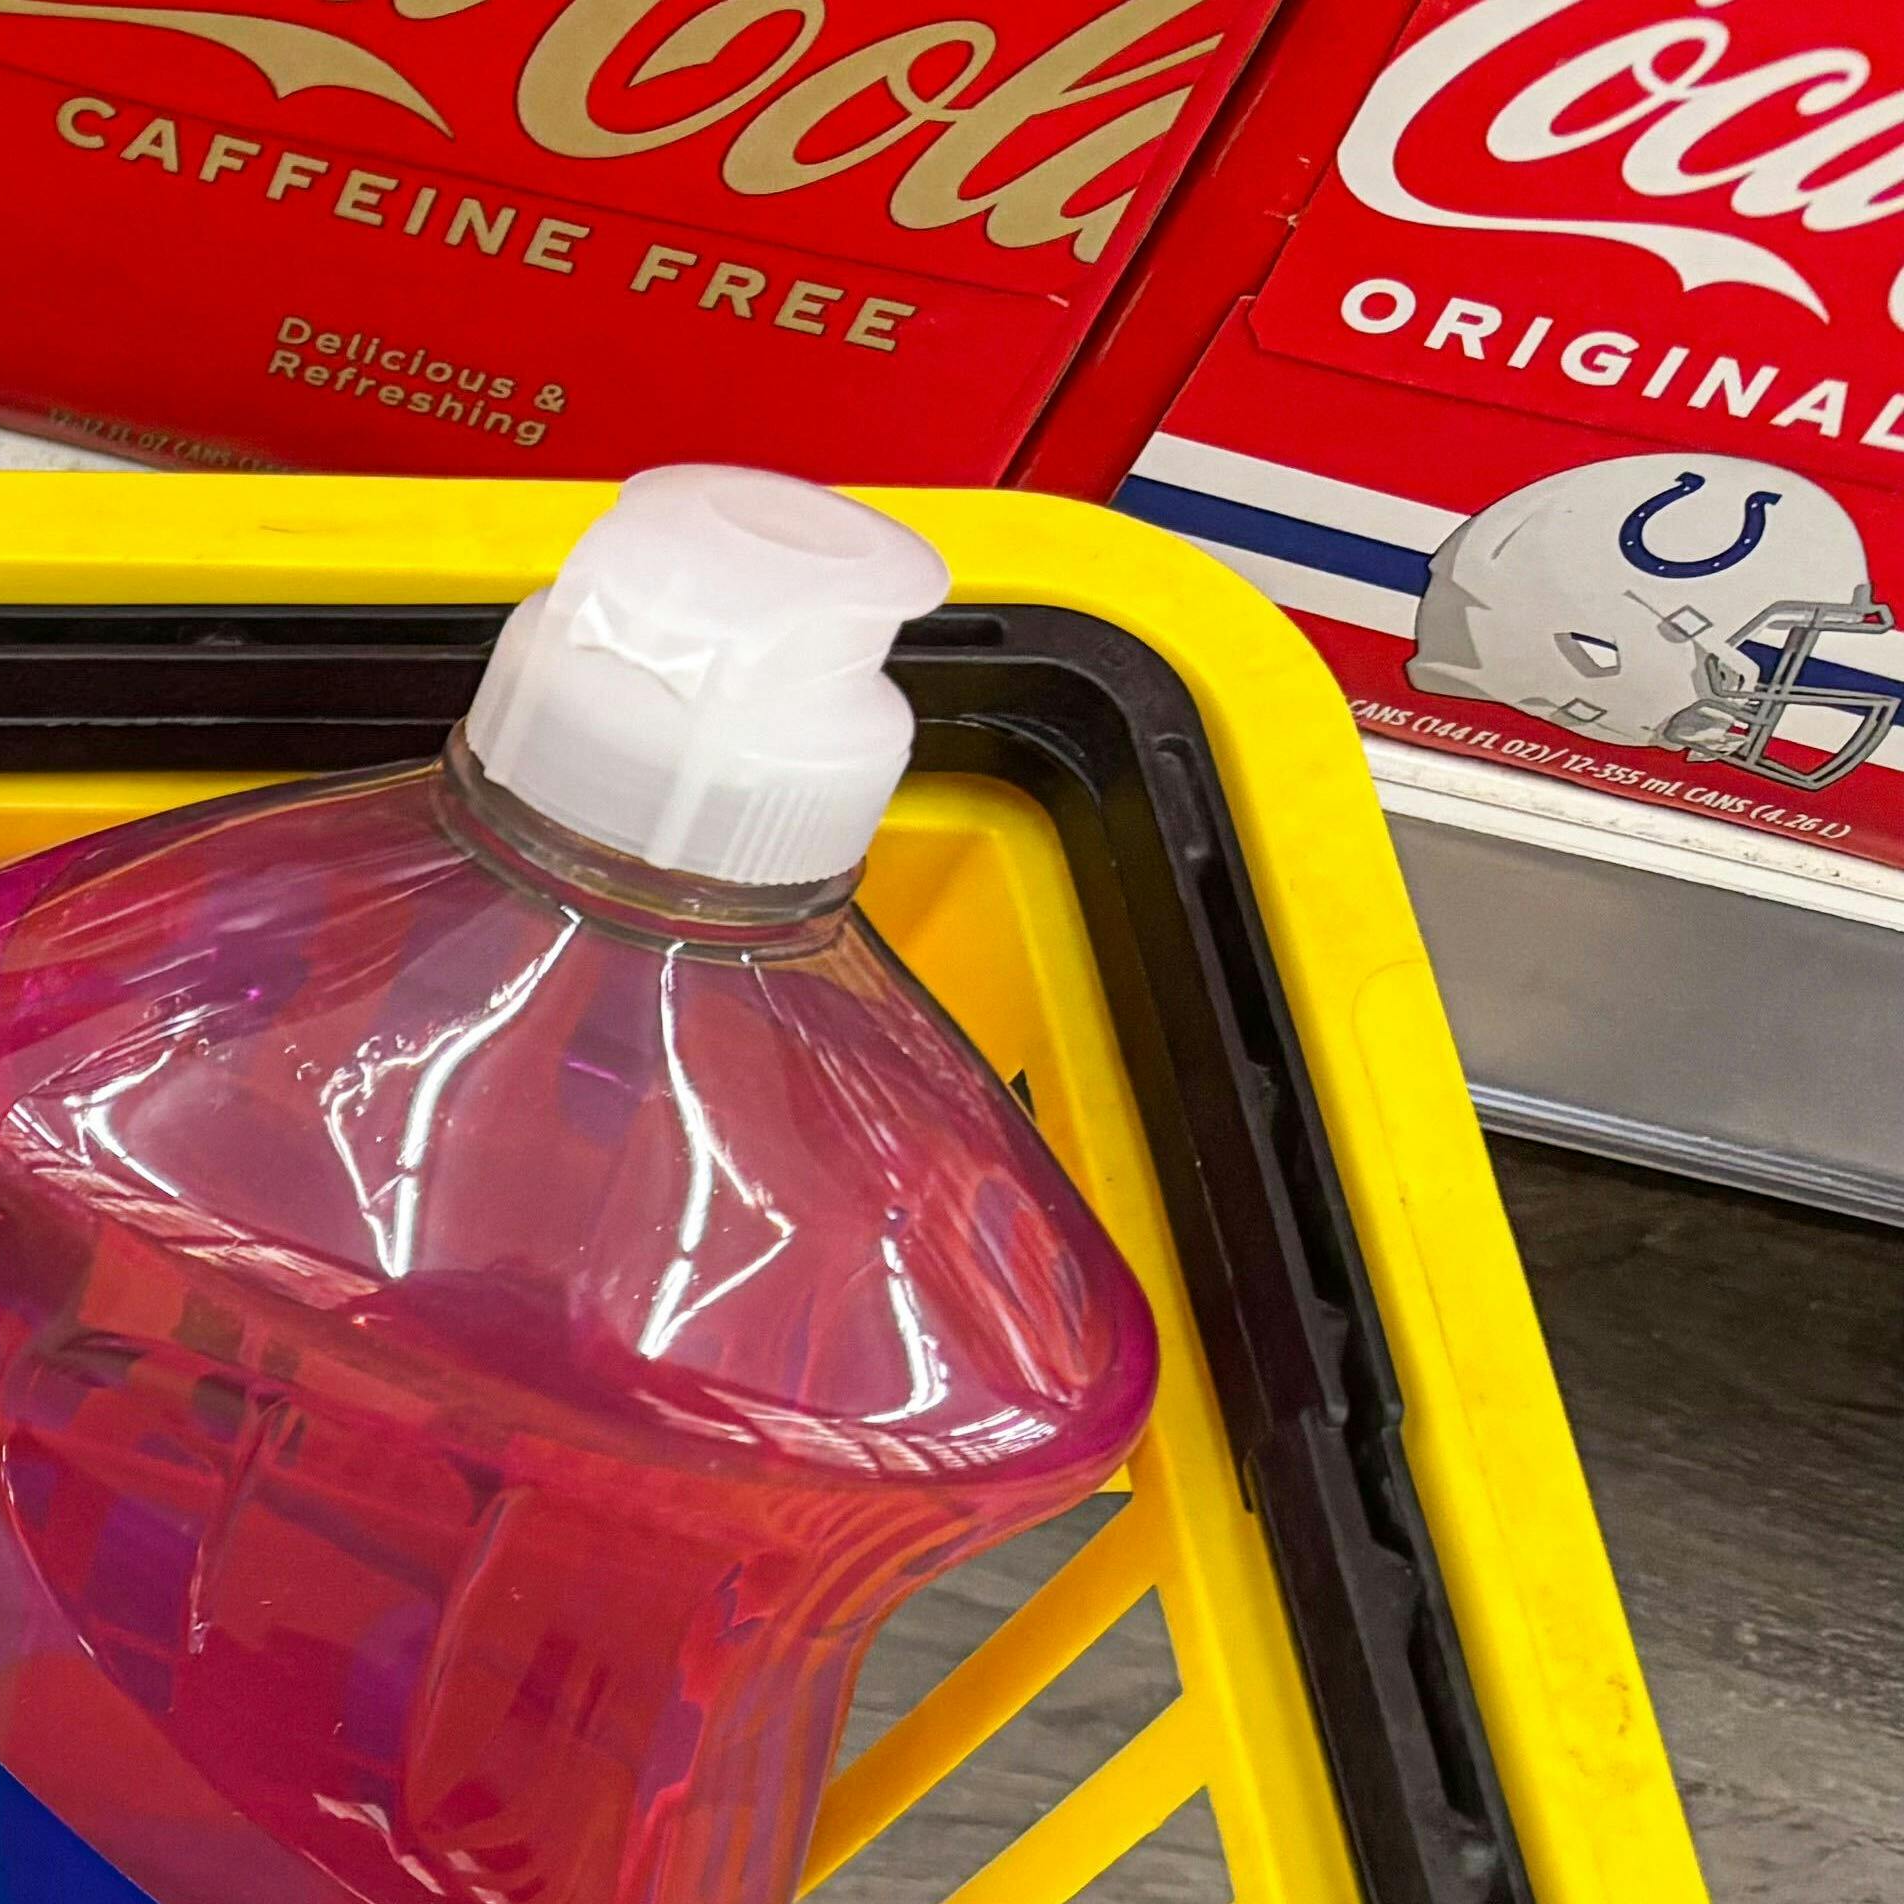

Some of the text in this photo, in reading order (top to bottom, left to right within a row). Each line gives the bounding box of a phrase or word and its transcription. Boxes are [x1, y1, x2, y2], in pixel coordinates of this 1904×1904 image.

[53, 94, 919, 356] CAFFEINE FREE
[266, 347, 549, 449] Refreshing
[274, 315, 568, 416] Delicious &
[1411, 712, 1470, 750] (144
[1471, 726, 1504, 752] FL
[1567, 750, 1640, 788] 12-355
[1640, 771, 1683, 799] mL
[1683, 784, 1750, 817] CANS
